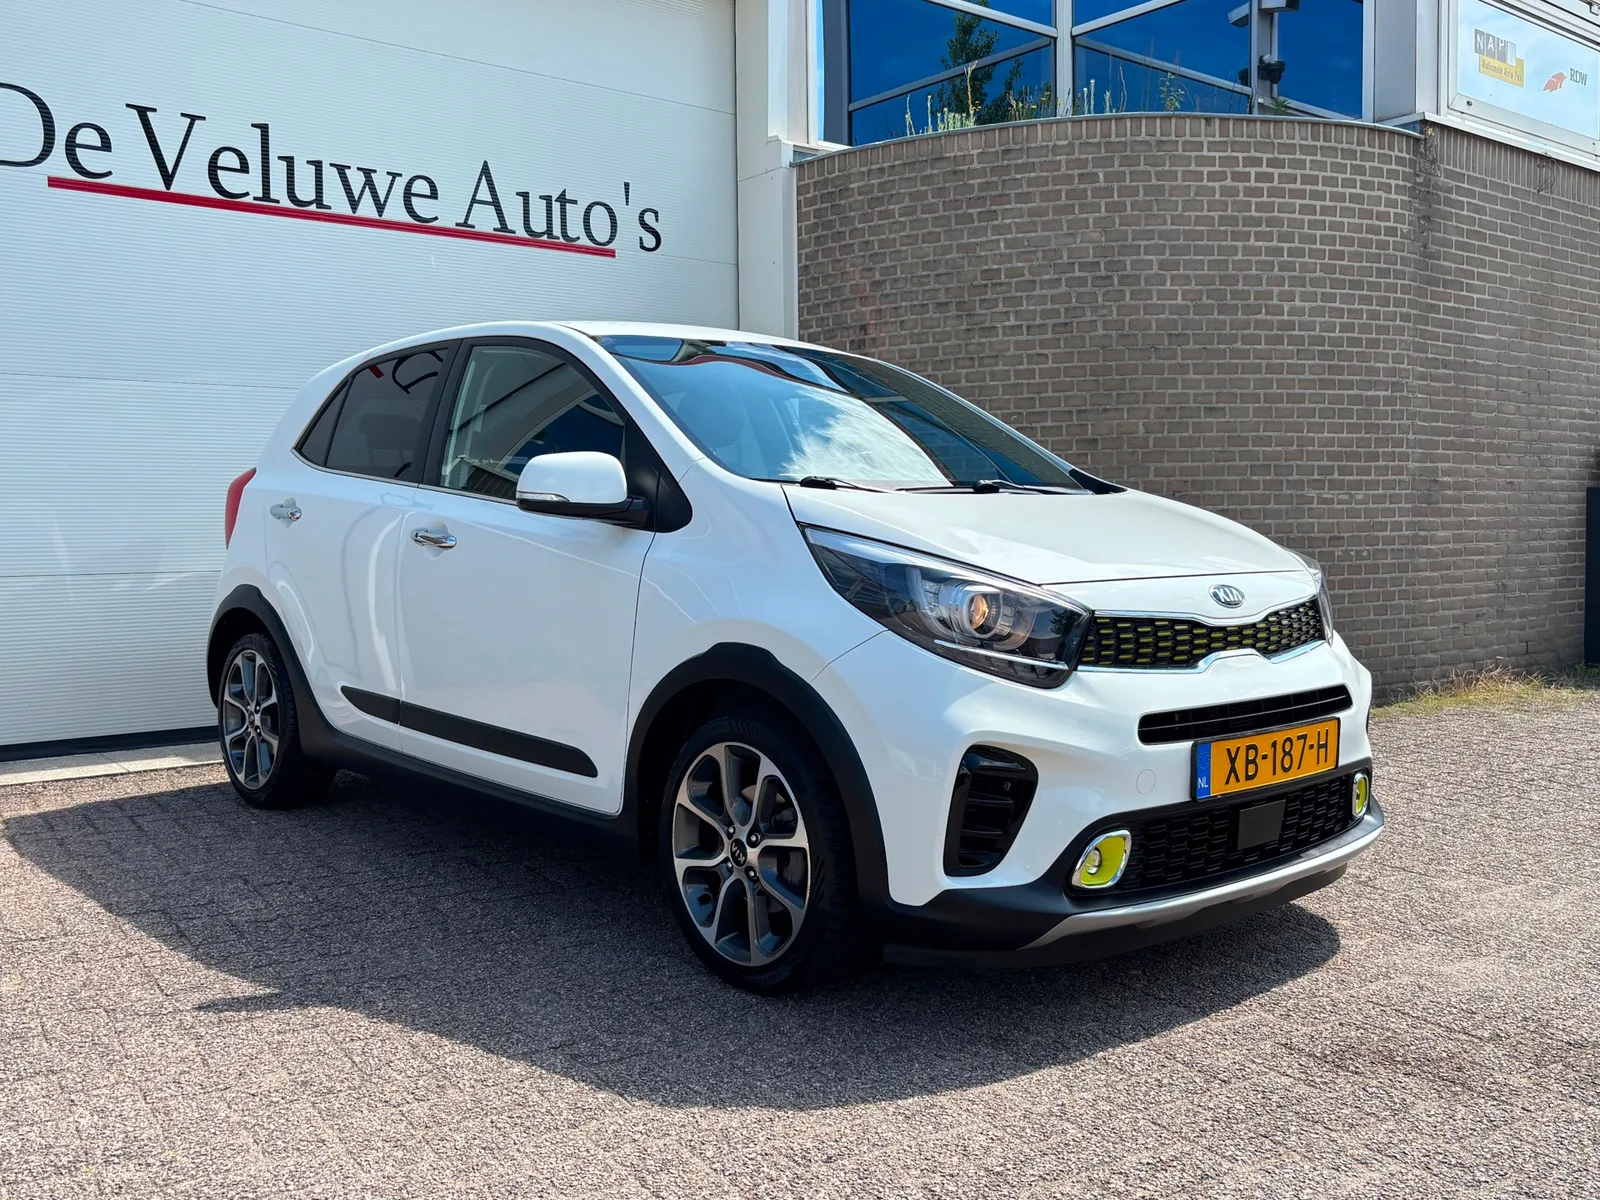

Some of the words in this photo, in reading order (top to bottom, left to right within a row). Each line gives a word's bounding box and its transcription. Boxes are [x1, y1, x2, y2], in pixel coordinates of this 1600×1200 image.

[1476, 33, 1506, 51] NAP
[1570, 67, 1588, 86] RDW
[0, 82, 114, 180] De
[125, 102, 440, 224] Veluwe
[455, 159, 663, 253] Auto's
[1214, 587, 1243, 602] KIA
[1224, 728, 1329, 786] XB-187-H
[1197, 776, 1209, 789] NL
[732, 842, 746, 864] KIA
